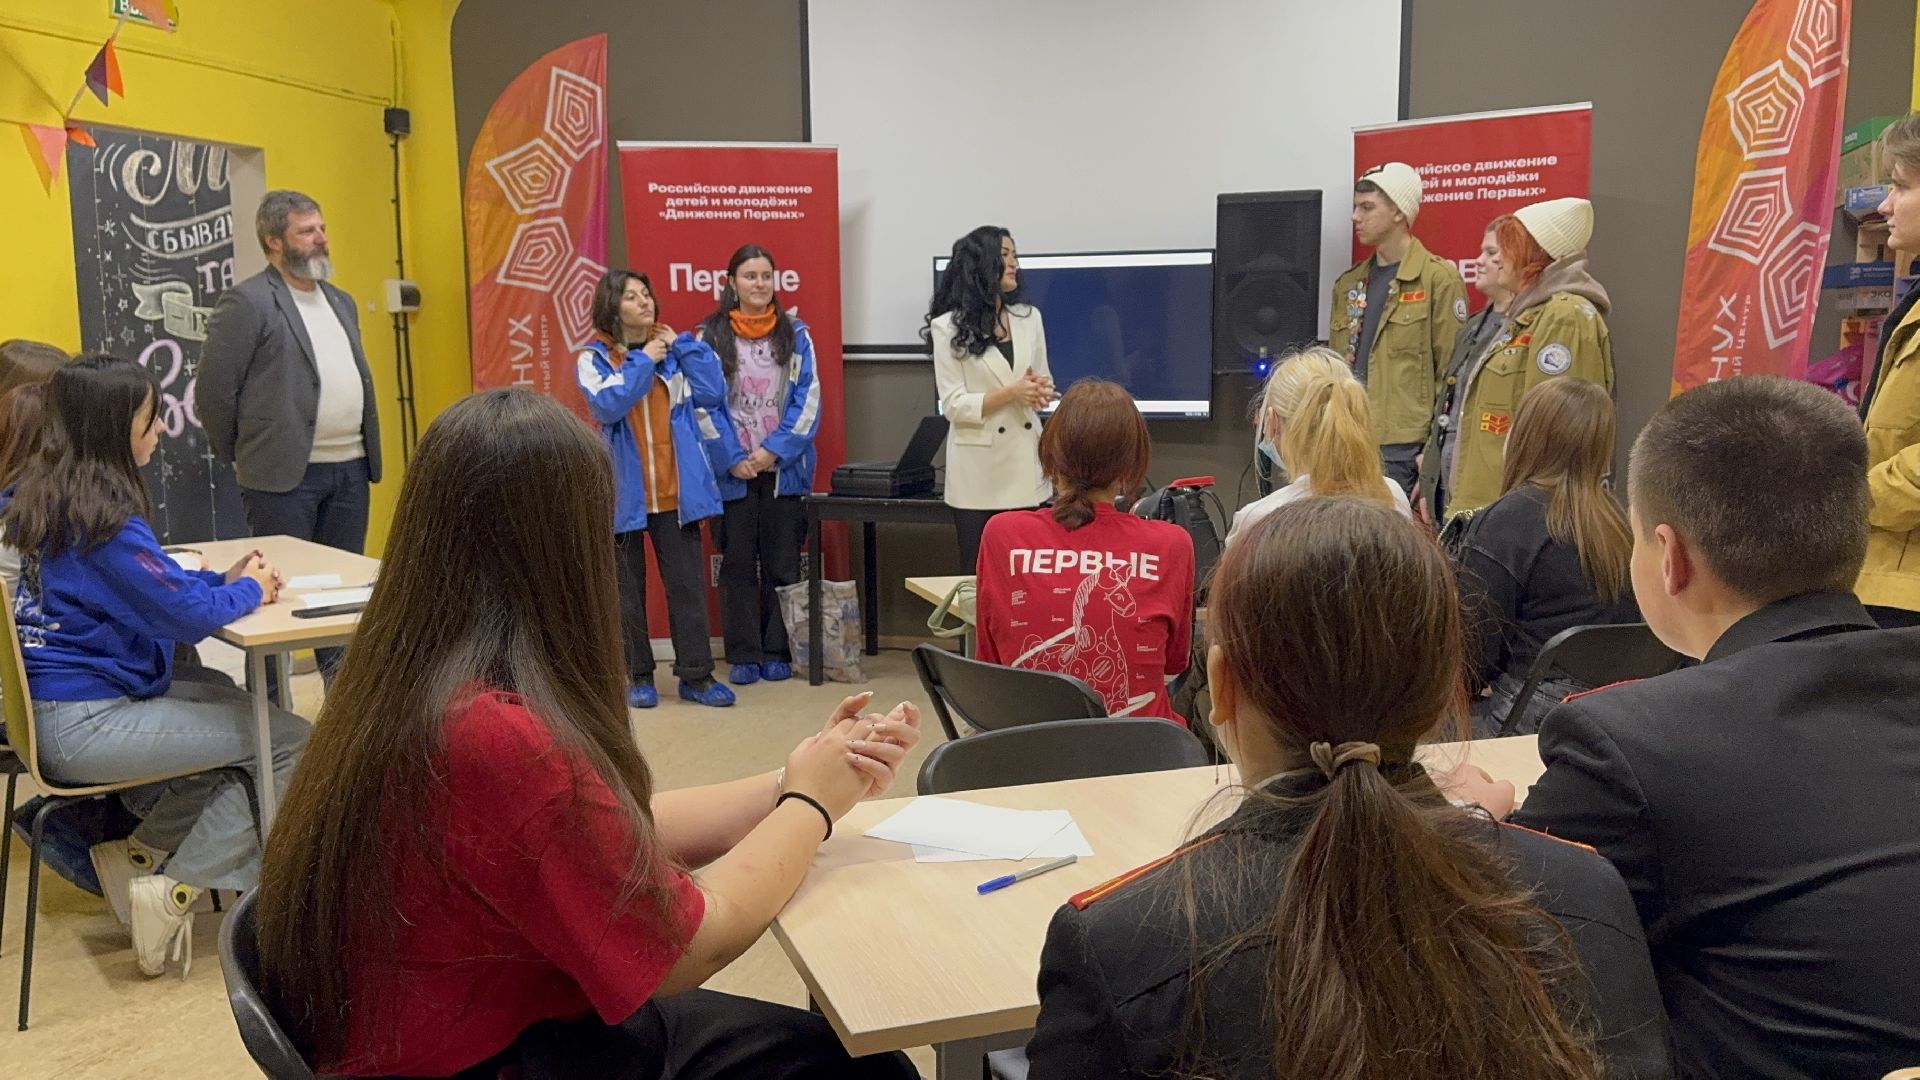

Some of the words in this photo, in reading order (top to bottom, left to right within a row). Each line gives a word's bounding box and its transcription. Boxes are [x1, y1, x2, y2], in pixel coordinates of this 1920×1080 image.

[1474, 155, 1558, 172] движение
[1442, 178, 1453, 188] и
[1455, 171, 1540, 187] молодёжи
[648, 182, 737, 195] Российское
[738, 185, 812, 195] движение
[665, 196, 708, 207] детей
[711, 199, 721, 207] и
[723, 196, 798, 208] молодёжи
[1009, 548, 1160, 581] ПЕРВЫЕ
